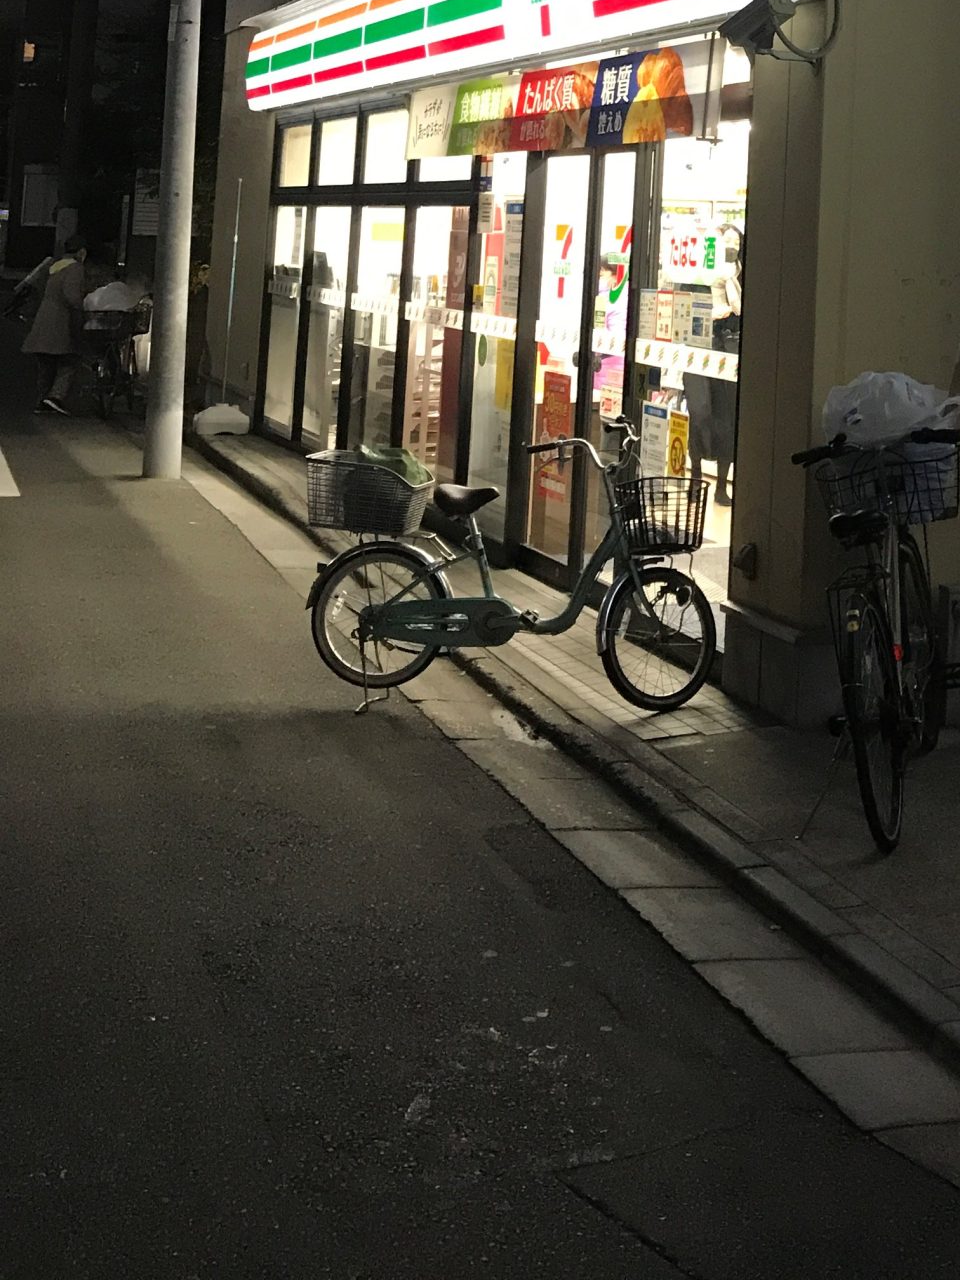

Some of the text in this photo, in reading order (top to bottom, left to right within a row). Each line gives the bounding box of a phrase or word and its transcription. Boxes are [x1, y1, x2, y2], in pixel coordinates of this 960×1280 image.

[522, 74, 576, 114] たんぱく質
[600, 63, 633, 107] 糖質
[597, 110, 623, 136] 控えめ
[670, 235, 698, 268] たばこ
[703, 236, 717, 269] 酒
